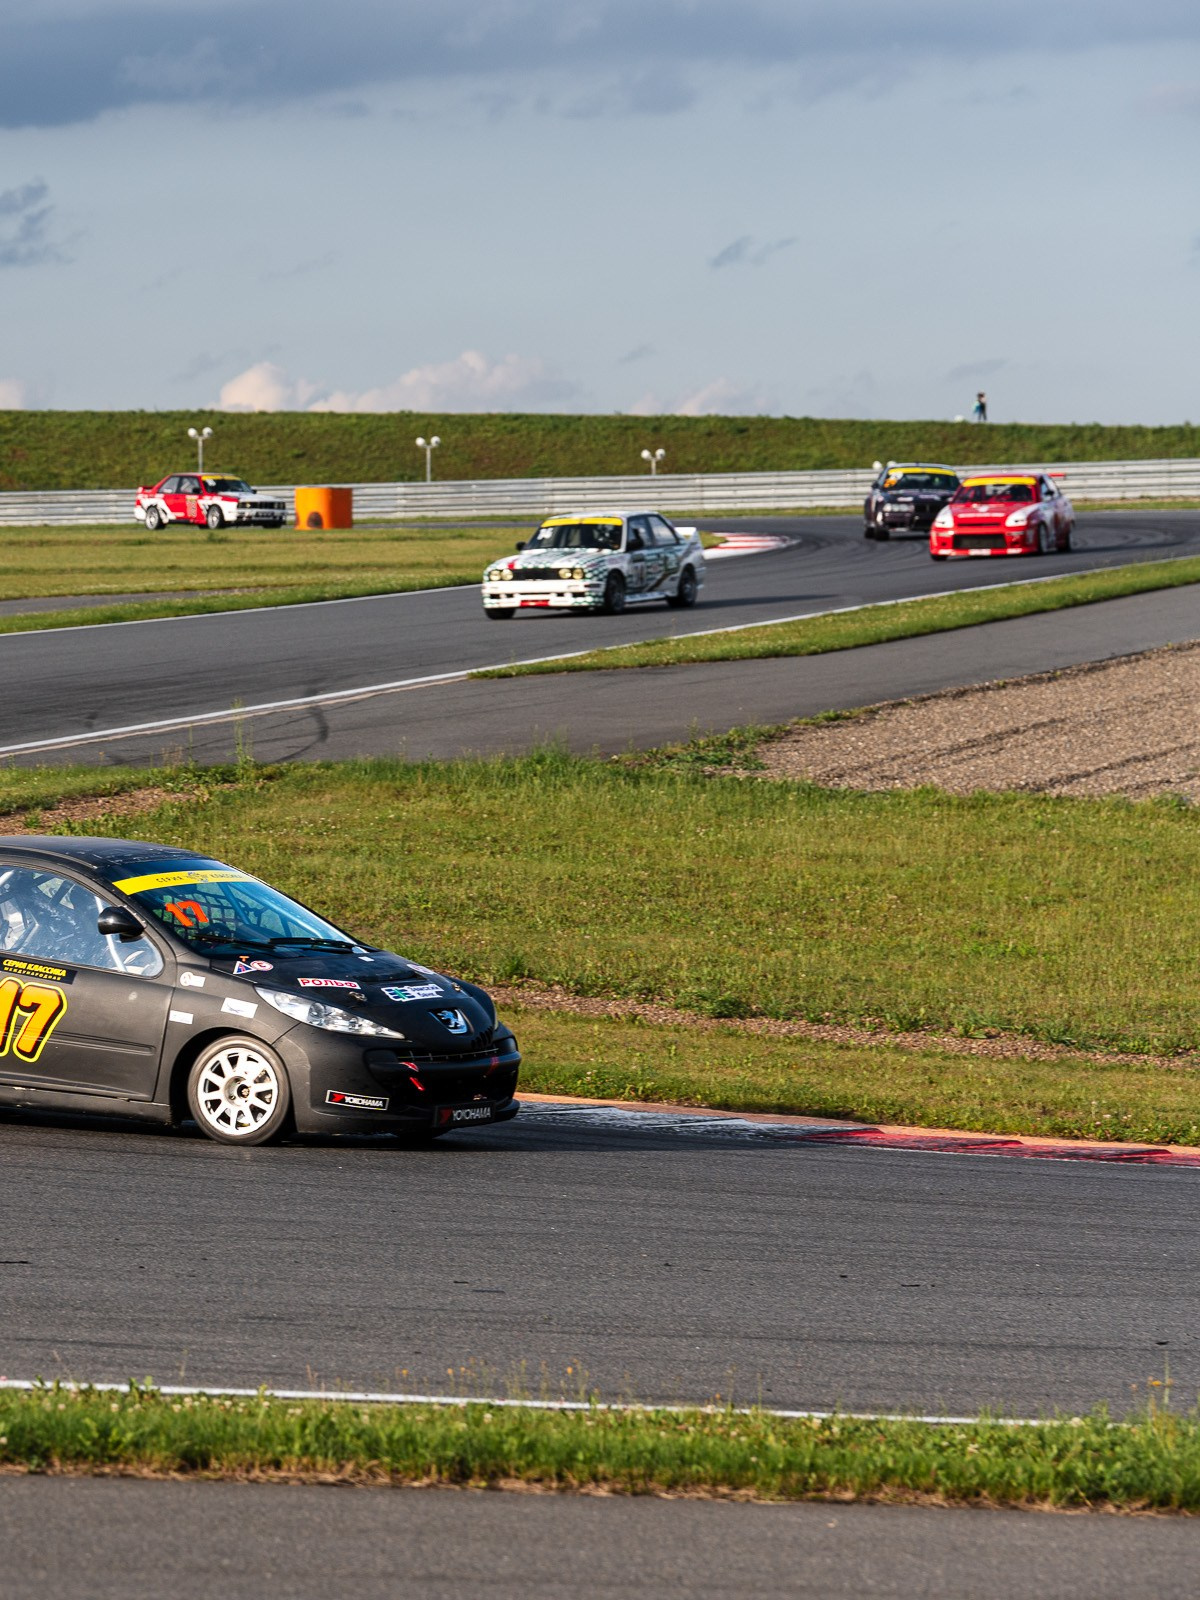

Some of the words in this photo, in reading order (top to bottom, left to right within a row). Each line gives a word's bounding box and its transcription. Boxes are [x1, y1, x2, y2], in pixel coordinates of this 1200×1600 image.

[164, 900, 209, 927] 17
[3, 959, 27, 970] СЕРИЯ
[300, 979, 357, 988] РОЛЬФ
[345, 1096, 383, 1107] YOKOHAMA
[452, 1107, 491, 1121] YOKOHAMA
